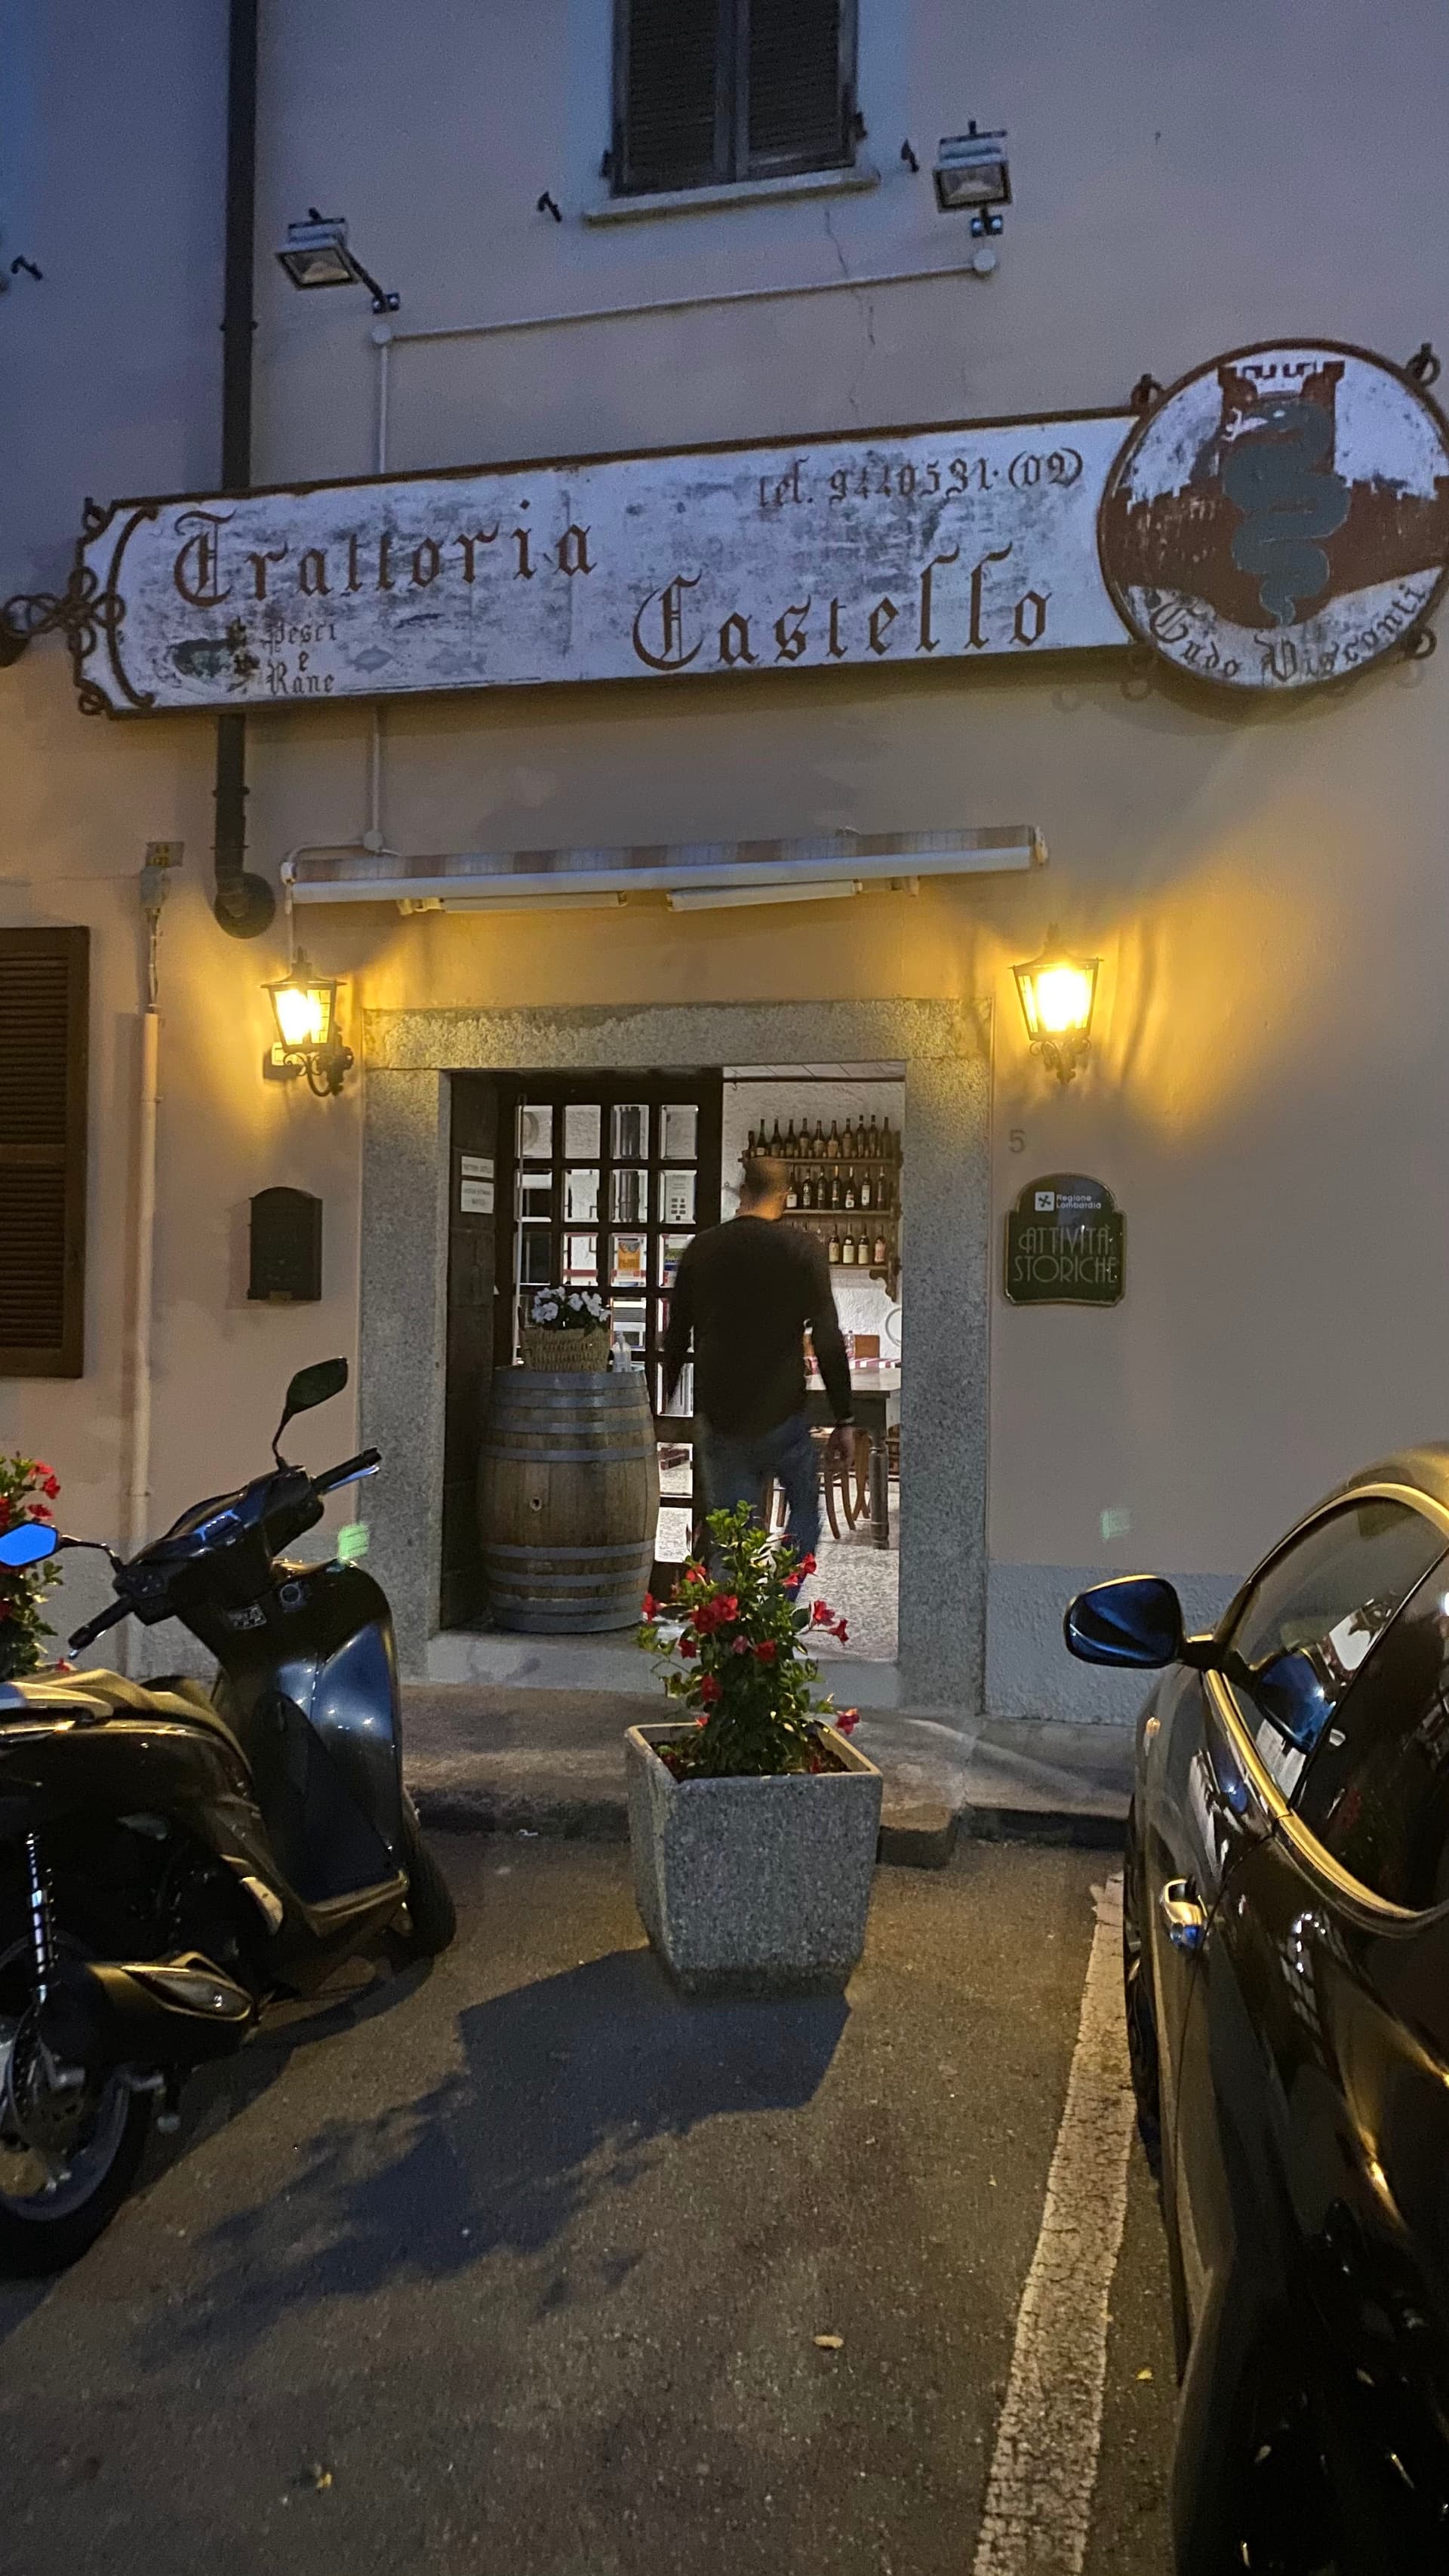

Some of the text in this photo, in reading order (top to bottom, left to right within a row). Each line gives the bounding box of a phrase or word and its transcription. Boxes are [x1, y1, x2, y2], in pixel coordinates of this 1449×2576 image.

[173, 499, 598, 606] Trattoria
[632, 541, 1053, 671] Castello
[1254, 583, 1428, 682] Visconti
[265, 660, 335, 696] Rane
[1009, 1129, 1026, 1154] 5
[1057, 1194, 1091, 1203] Regione
[1057, 1202, 1102, 1210] Lombardia
[1019, 1224, 1111, 1255] ATTIVITÀ
[1013, 1255, 1118, 1283] STORICHE
